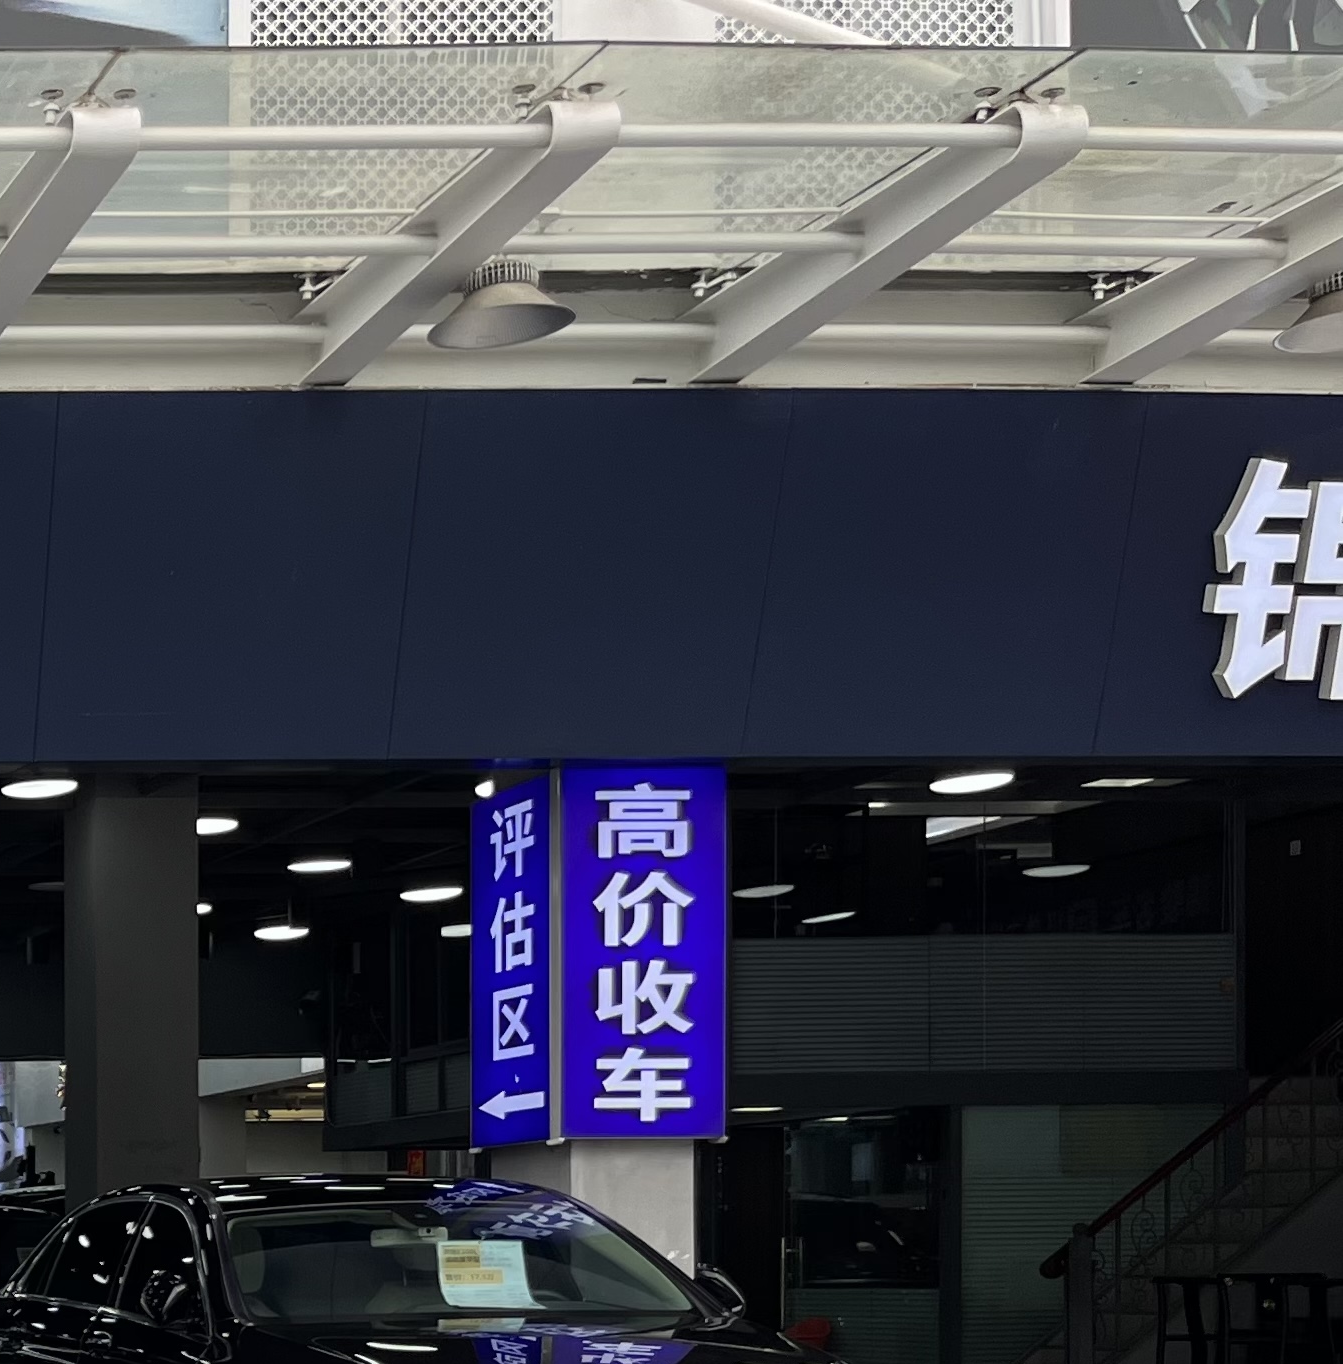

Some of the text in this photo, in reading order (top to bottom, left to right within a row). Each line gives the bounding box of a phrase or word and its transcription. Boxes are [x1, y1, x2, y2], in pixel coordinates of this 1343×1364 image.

[490, 798, 536, 1062] 评估区
[594, 782, 694, 1123] 高价收车
